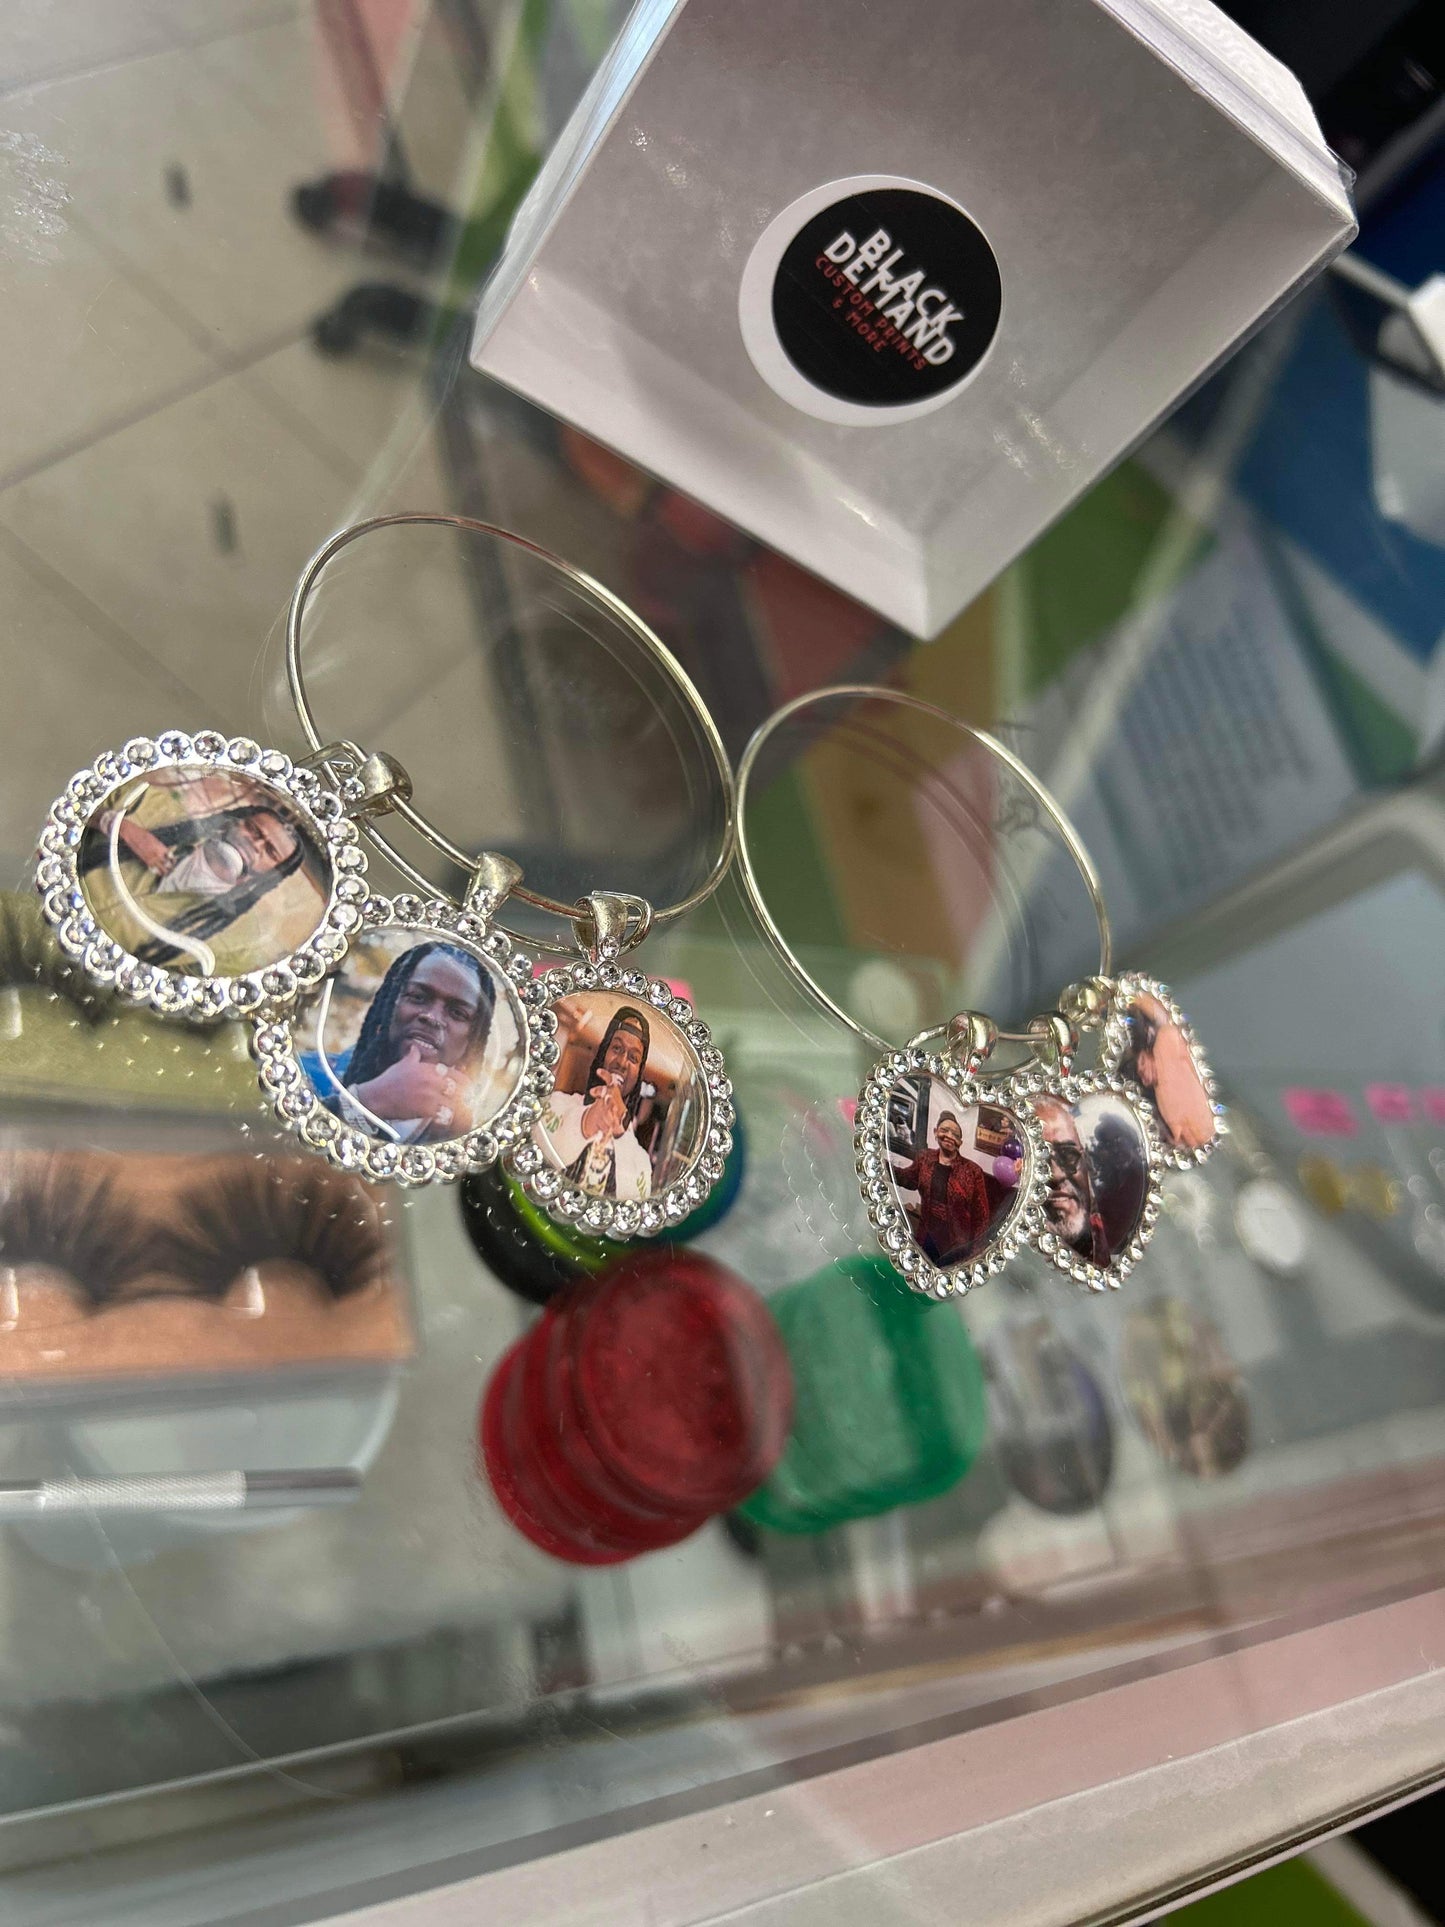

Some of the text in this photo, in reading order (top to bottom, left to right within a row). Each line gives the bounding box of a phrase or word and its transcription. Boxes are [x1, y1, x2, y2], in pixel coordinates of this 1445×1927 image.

[815, 256, 929, 371] CUSTOM PRINTS
[823, 231, 955, 366] DEMAND
[845, 311, 888, 353] MORE
[859, 228, 965, 336] BLACK
